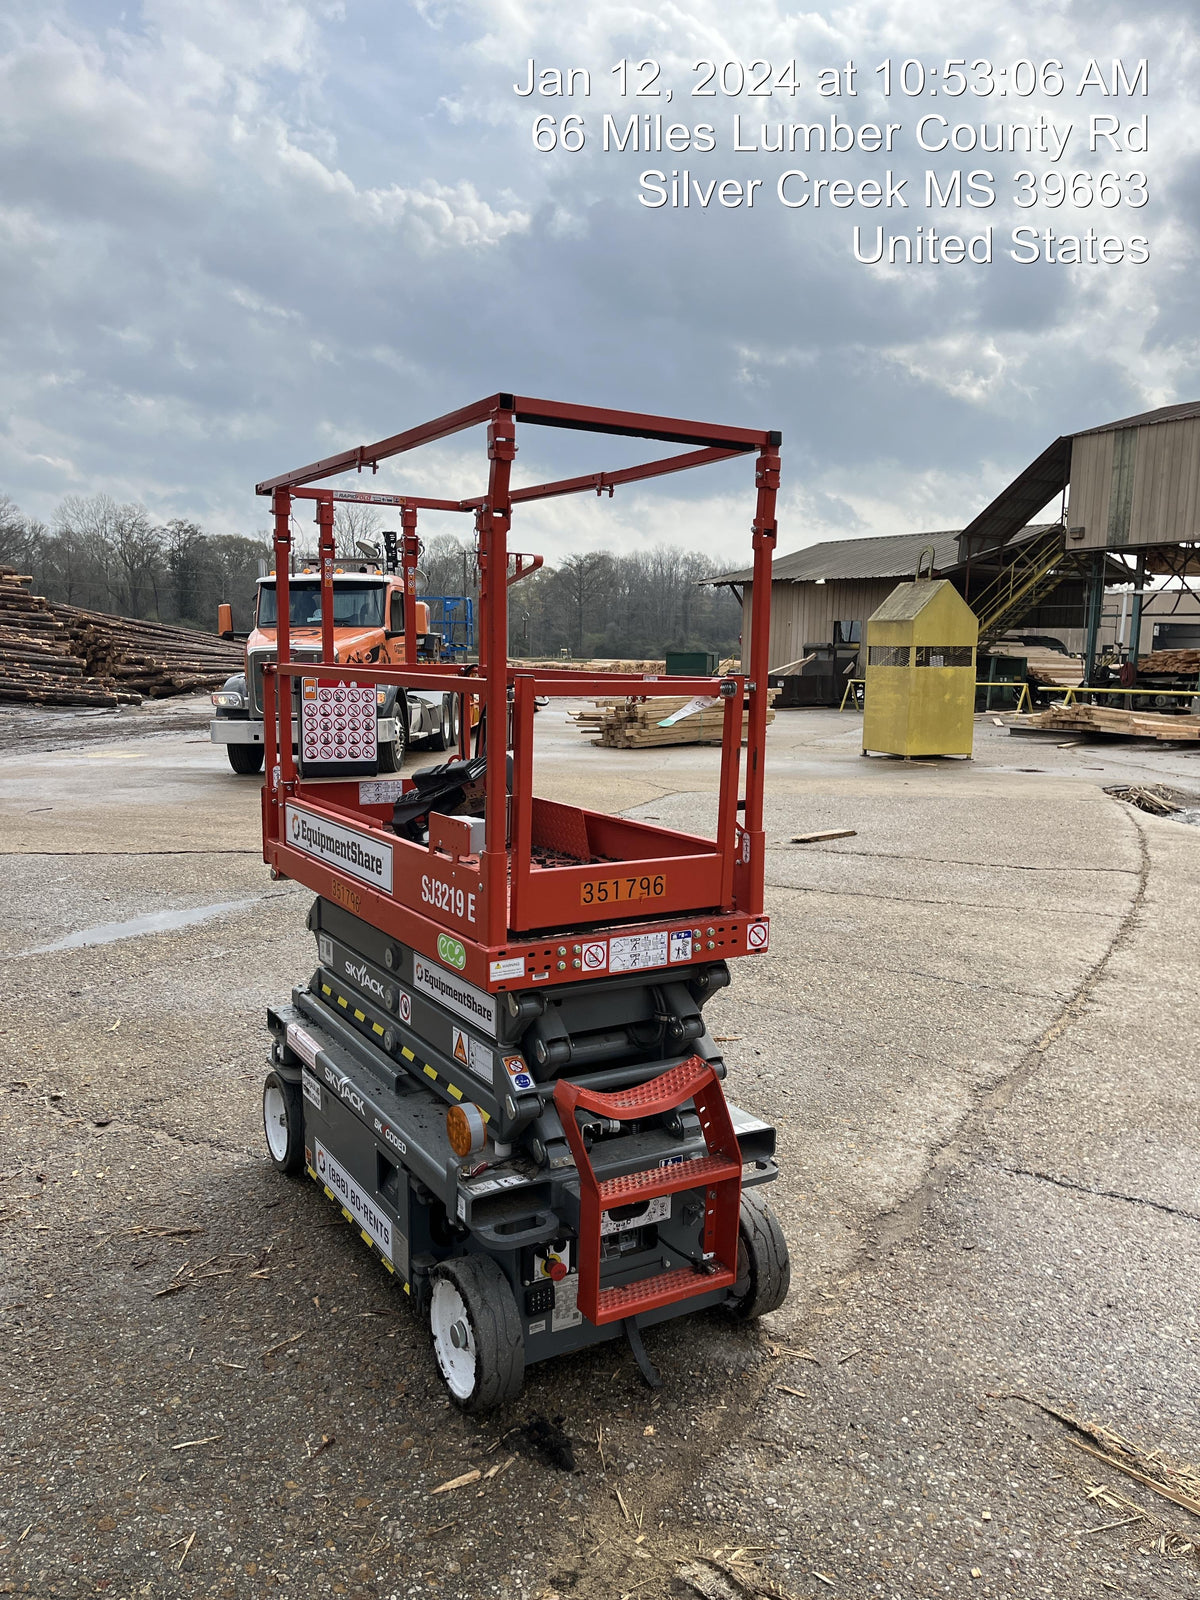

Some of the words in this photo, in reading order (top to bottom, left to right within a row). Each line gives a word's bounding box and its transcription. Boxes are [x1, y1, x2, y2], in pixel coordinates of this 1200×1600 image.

[301, 819, 383, 876] EquipmentShare
[331, 879, 361, 913] 351796
[421, 874, 464, 918] SJ3219
[467, 892, 476, 923] E
[583, 876, 664, 903] 351796
[438, 936, 464, 966] eco
[345, 961, 385, 999] SKYJACK
[424, 968, 492, 1022] EquipmentShare
[324, 1066, 366, 1116] SKYJACK
[328, 1163, 349, 1199] (888)
